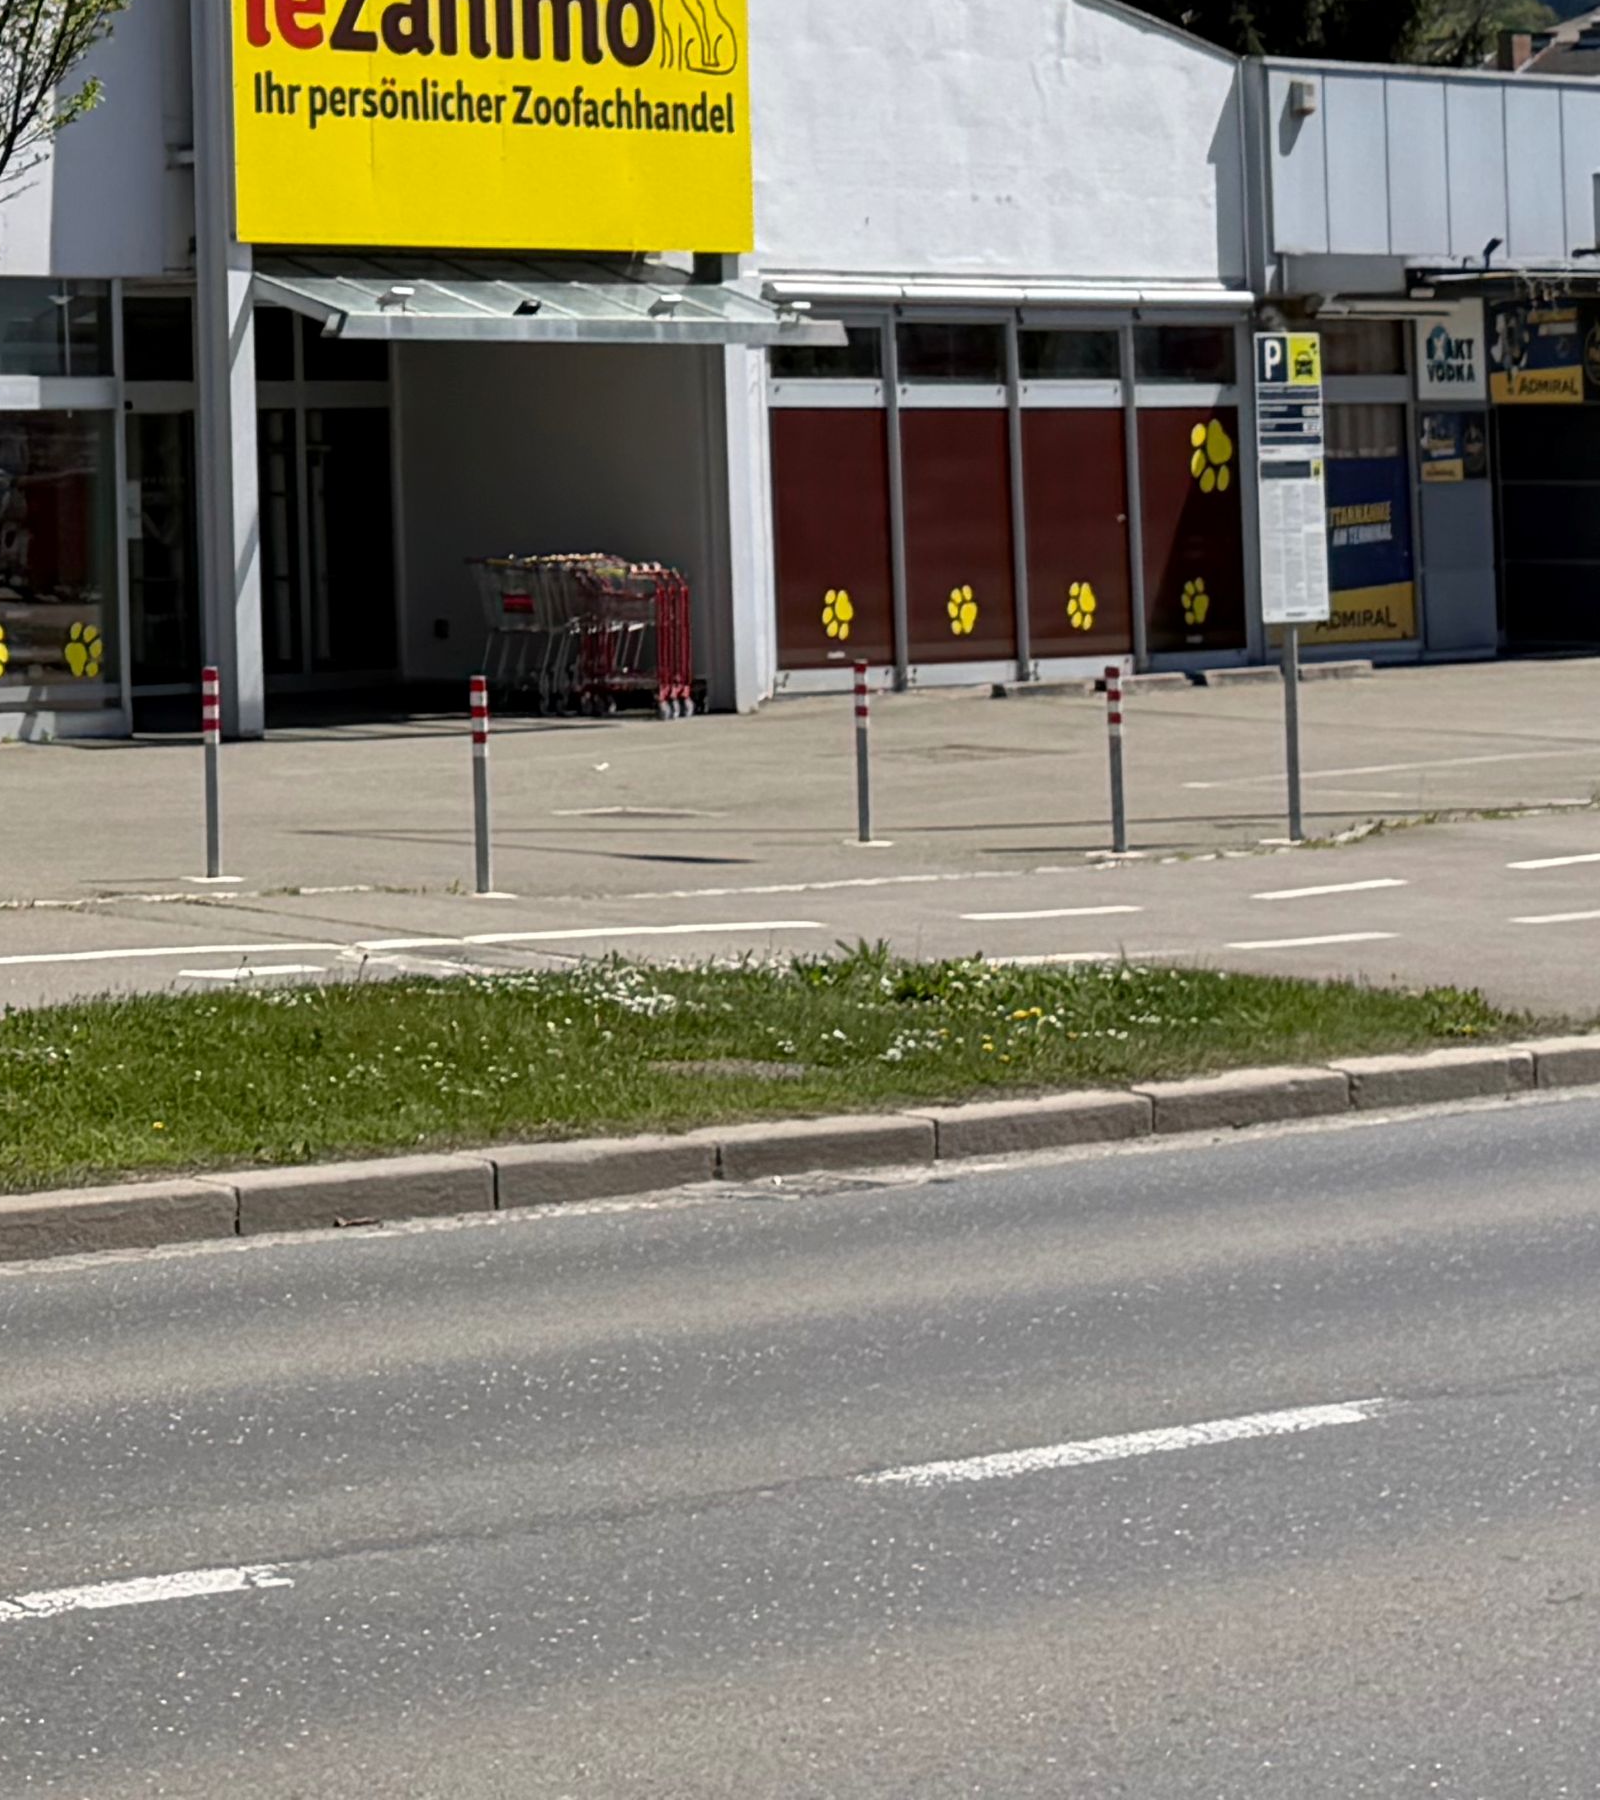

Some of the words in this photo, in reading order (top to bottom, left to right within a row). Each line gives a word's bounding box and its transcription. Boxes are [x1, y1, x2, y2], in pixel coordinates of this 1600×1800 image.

[254, 71, 302, 116] Ihr
[308, 76, 507, 129] persönlicher
[511, 85, 736, 135] Zoofachhandel
[1264, 338, 1282, 380] P
[1426, 362, 1476, 383] VODKA
[1518, 376, 1579, 396] ADMIRAL
